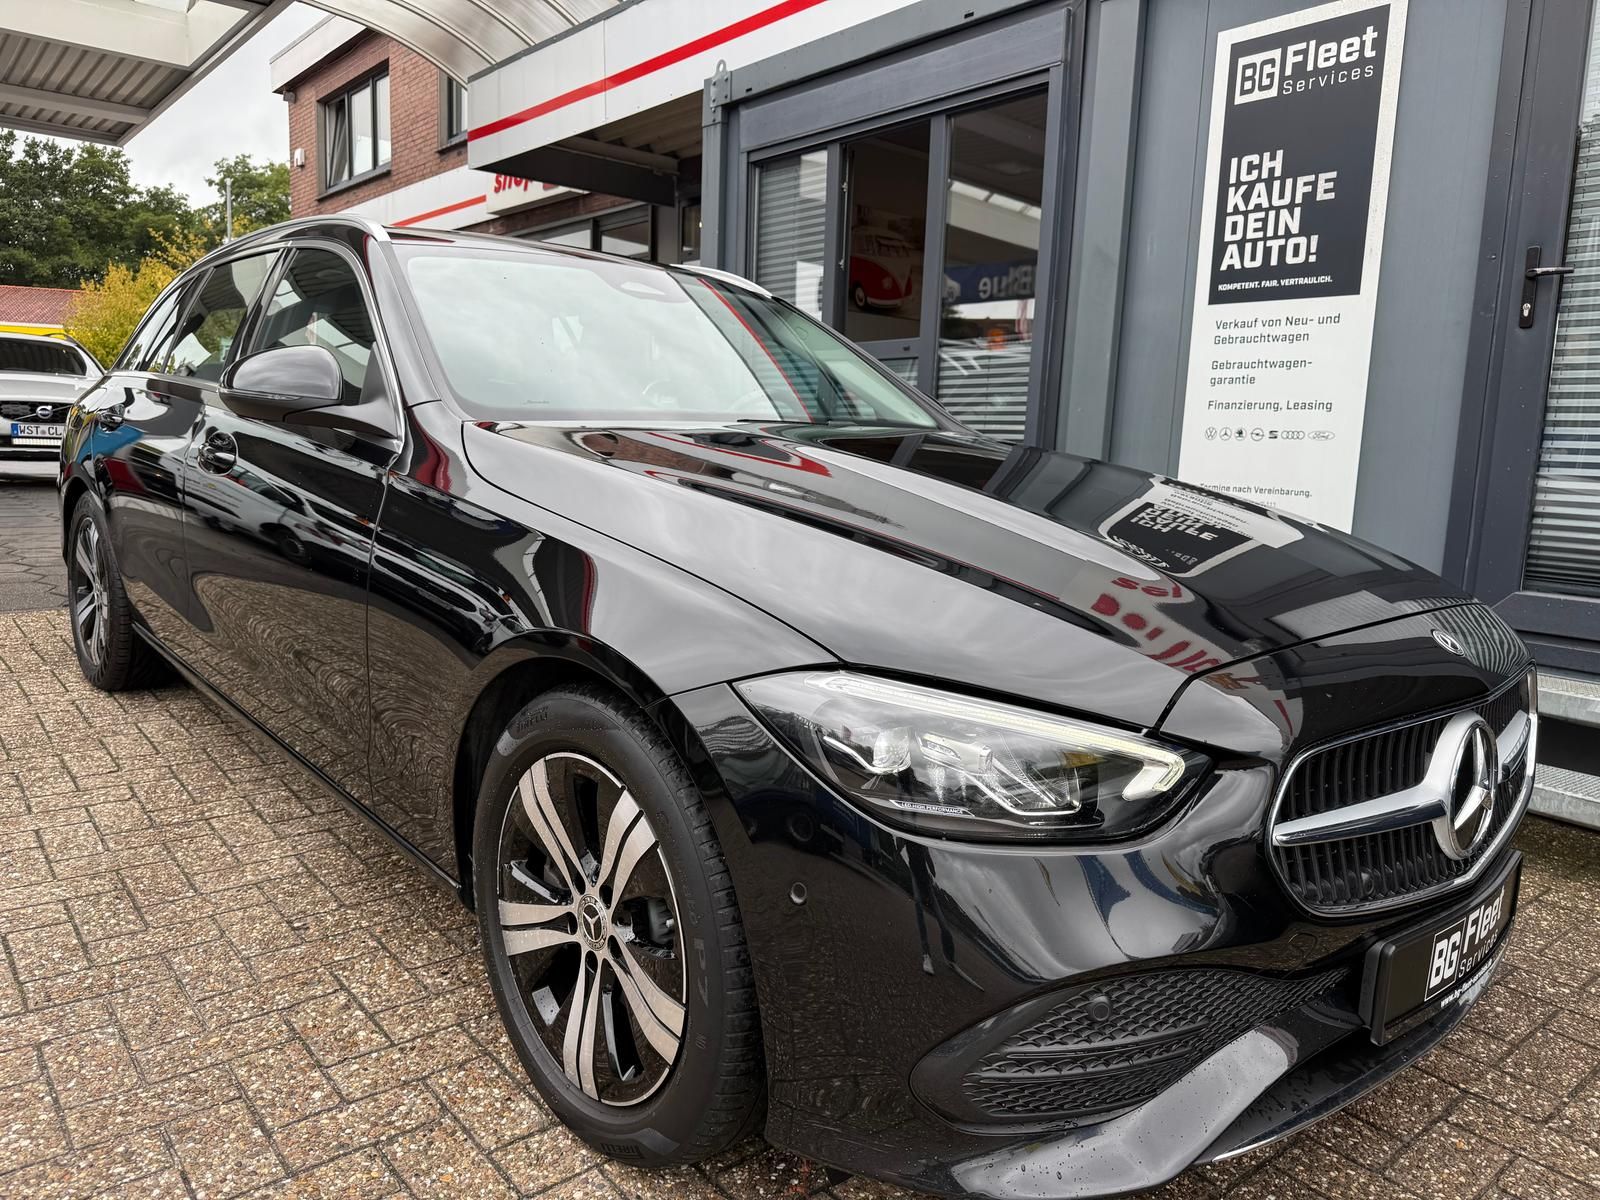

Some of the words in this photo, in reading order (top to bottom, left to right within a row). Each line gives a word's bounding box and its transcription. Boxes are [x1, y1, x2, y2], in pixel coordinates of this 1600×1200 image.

[1238, 55, 1278, 98] BG
[1284, 25, 1379, 77] Fleet
[1282, 65, 1375, 95] Services
[1228, 149, 1284, 184] ICH
[1226, 171, 1338, 213] KAUFE
[1223, 206, 1301, 242] DEIN
[1219, 234, 1319, 271] AUTO!
[1218, 281, 1261, 291] KOMPETENT.
[1261, 279, 1280, 288] FAIR.
[1280, 275, 1333, 286] VERTRAULICH.
[1215, 317, 1259, 330] Verkauf
[1261, 319, 1282, 328] von
[1285, 316, 1314, 326] Neu-
[1317, 313, 1341, 325] und
[1213, 332, 1310, 345] Gebrauchtwagen
[1211, 358, 1313, 371] Gebrauchtwagen-
[1209, 375, 1256, 387] garantie
[1207, 400, 1283, 412] Finanzierung,
[1285, 400, 1333, 412] Leasing
[19, 425, 41, 435] WST
[1232, 485, 1252, 494] nach
[1254, 486, 1312, 498] Vereinbarung.
[1429, 930, 1461, 989] BG
[1463, 885, 1505, 955] Fleet
[1459, 928, 1499, 979] Services
